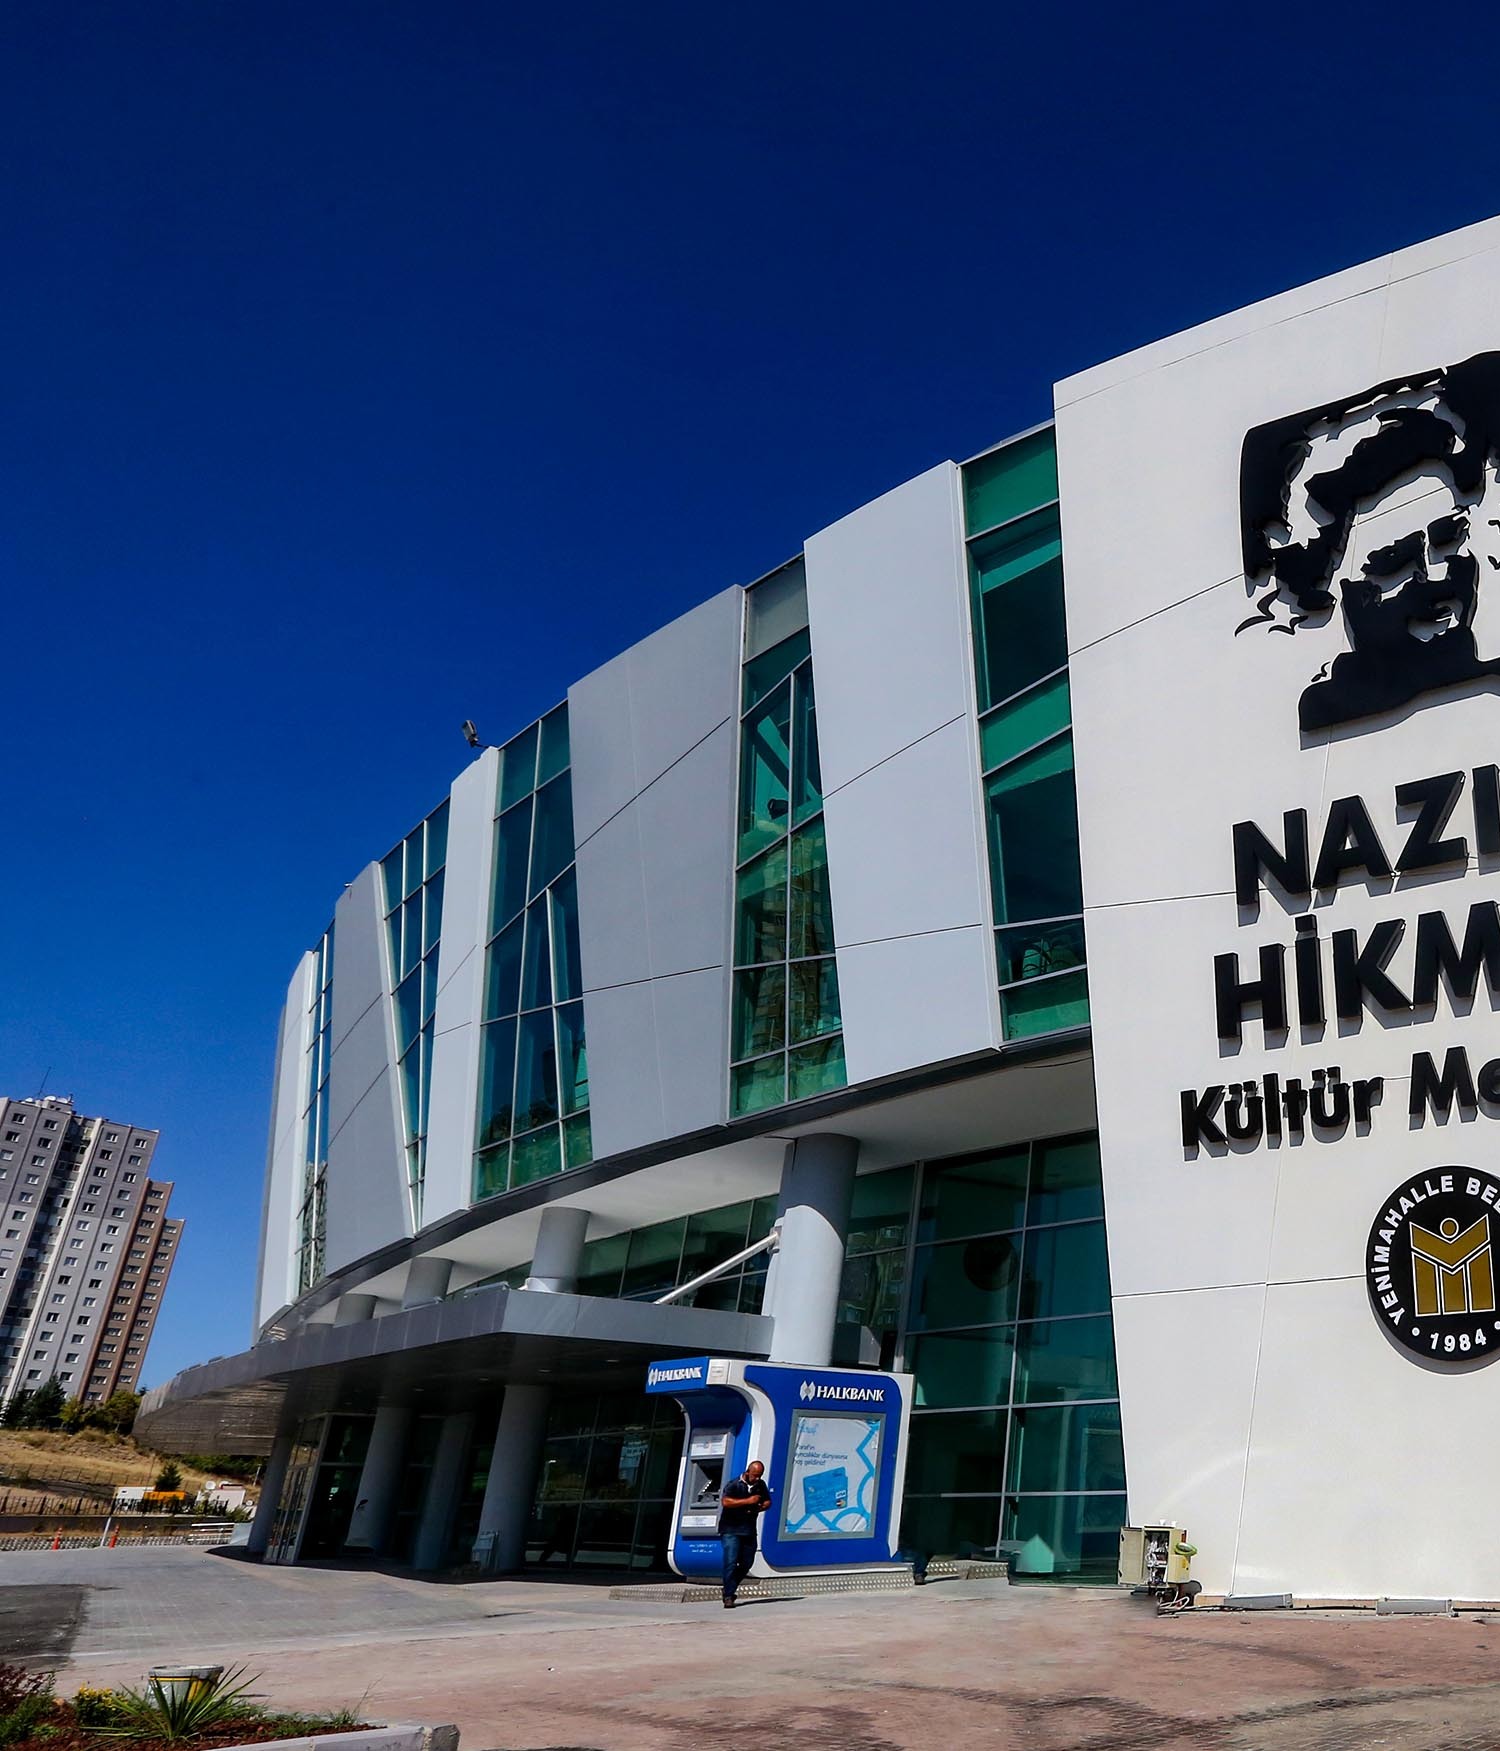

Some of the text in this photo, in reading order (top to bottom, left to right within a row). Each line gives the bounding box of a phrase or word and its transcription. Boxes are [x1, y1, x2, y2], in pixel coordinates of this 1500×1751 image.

[1180, 1066, 1383, 1150] Kültür
[1371, 1175, 1454, 1326] YENİMAHALLE
[1430, 1328, 1487, 1352] 1984
[657, 1366, 702, 1382] HALKBANK
[816, 1385, 885, 1402] HALKBANK
